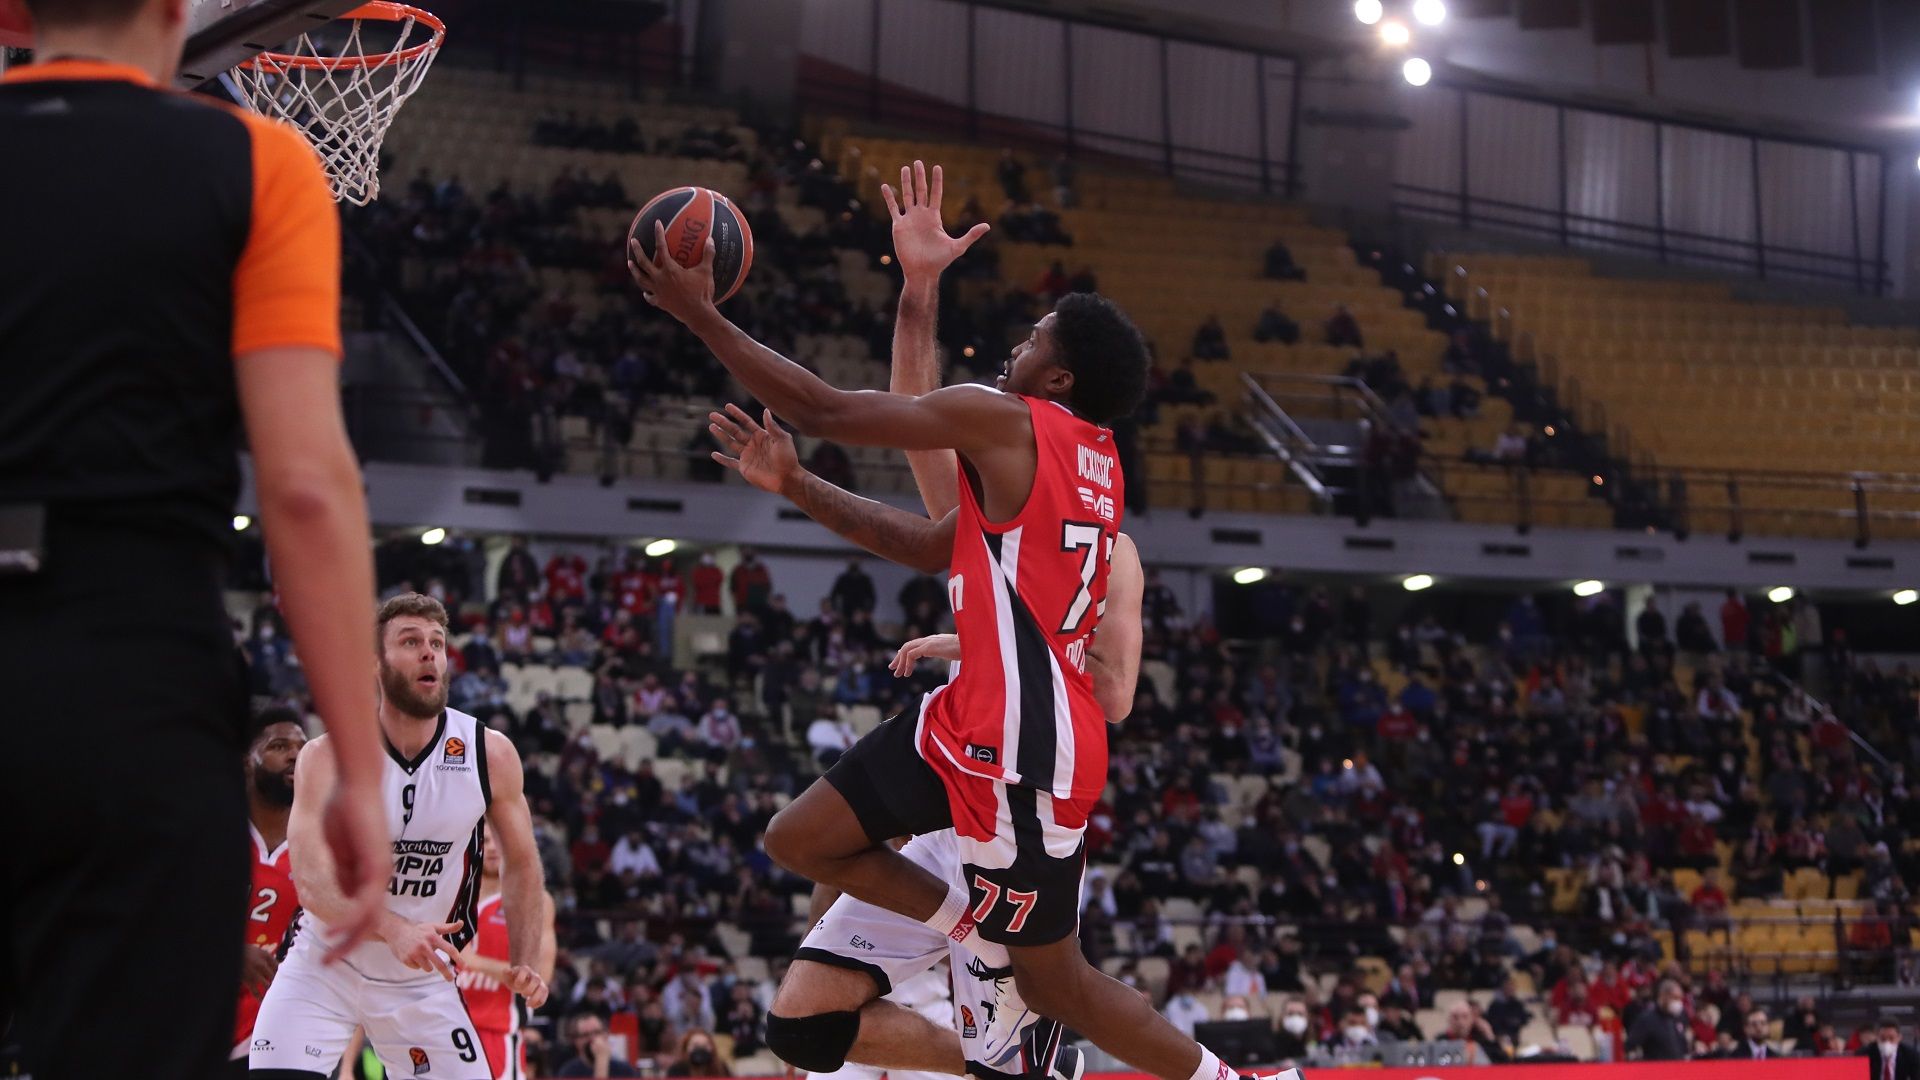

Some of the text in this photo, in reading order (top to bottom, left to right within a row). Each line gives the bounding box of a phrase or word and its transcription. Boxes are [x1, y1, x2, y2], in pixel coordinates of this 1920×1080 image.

[402, 783, 416, 825] 9
[972, 873, 1038, 933] 77
[851, 934, 876, 952] EA7
[450, 1027, 478, 1063] 9
